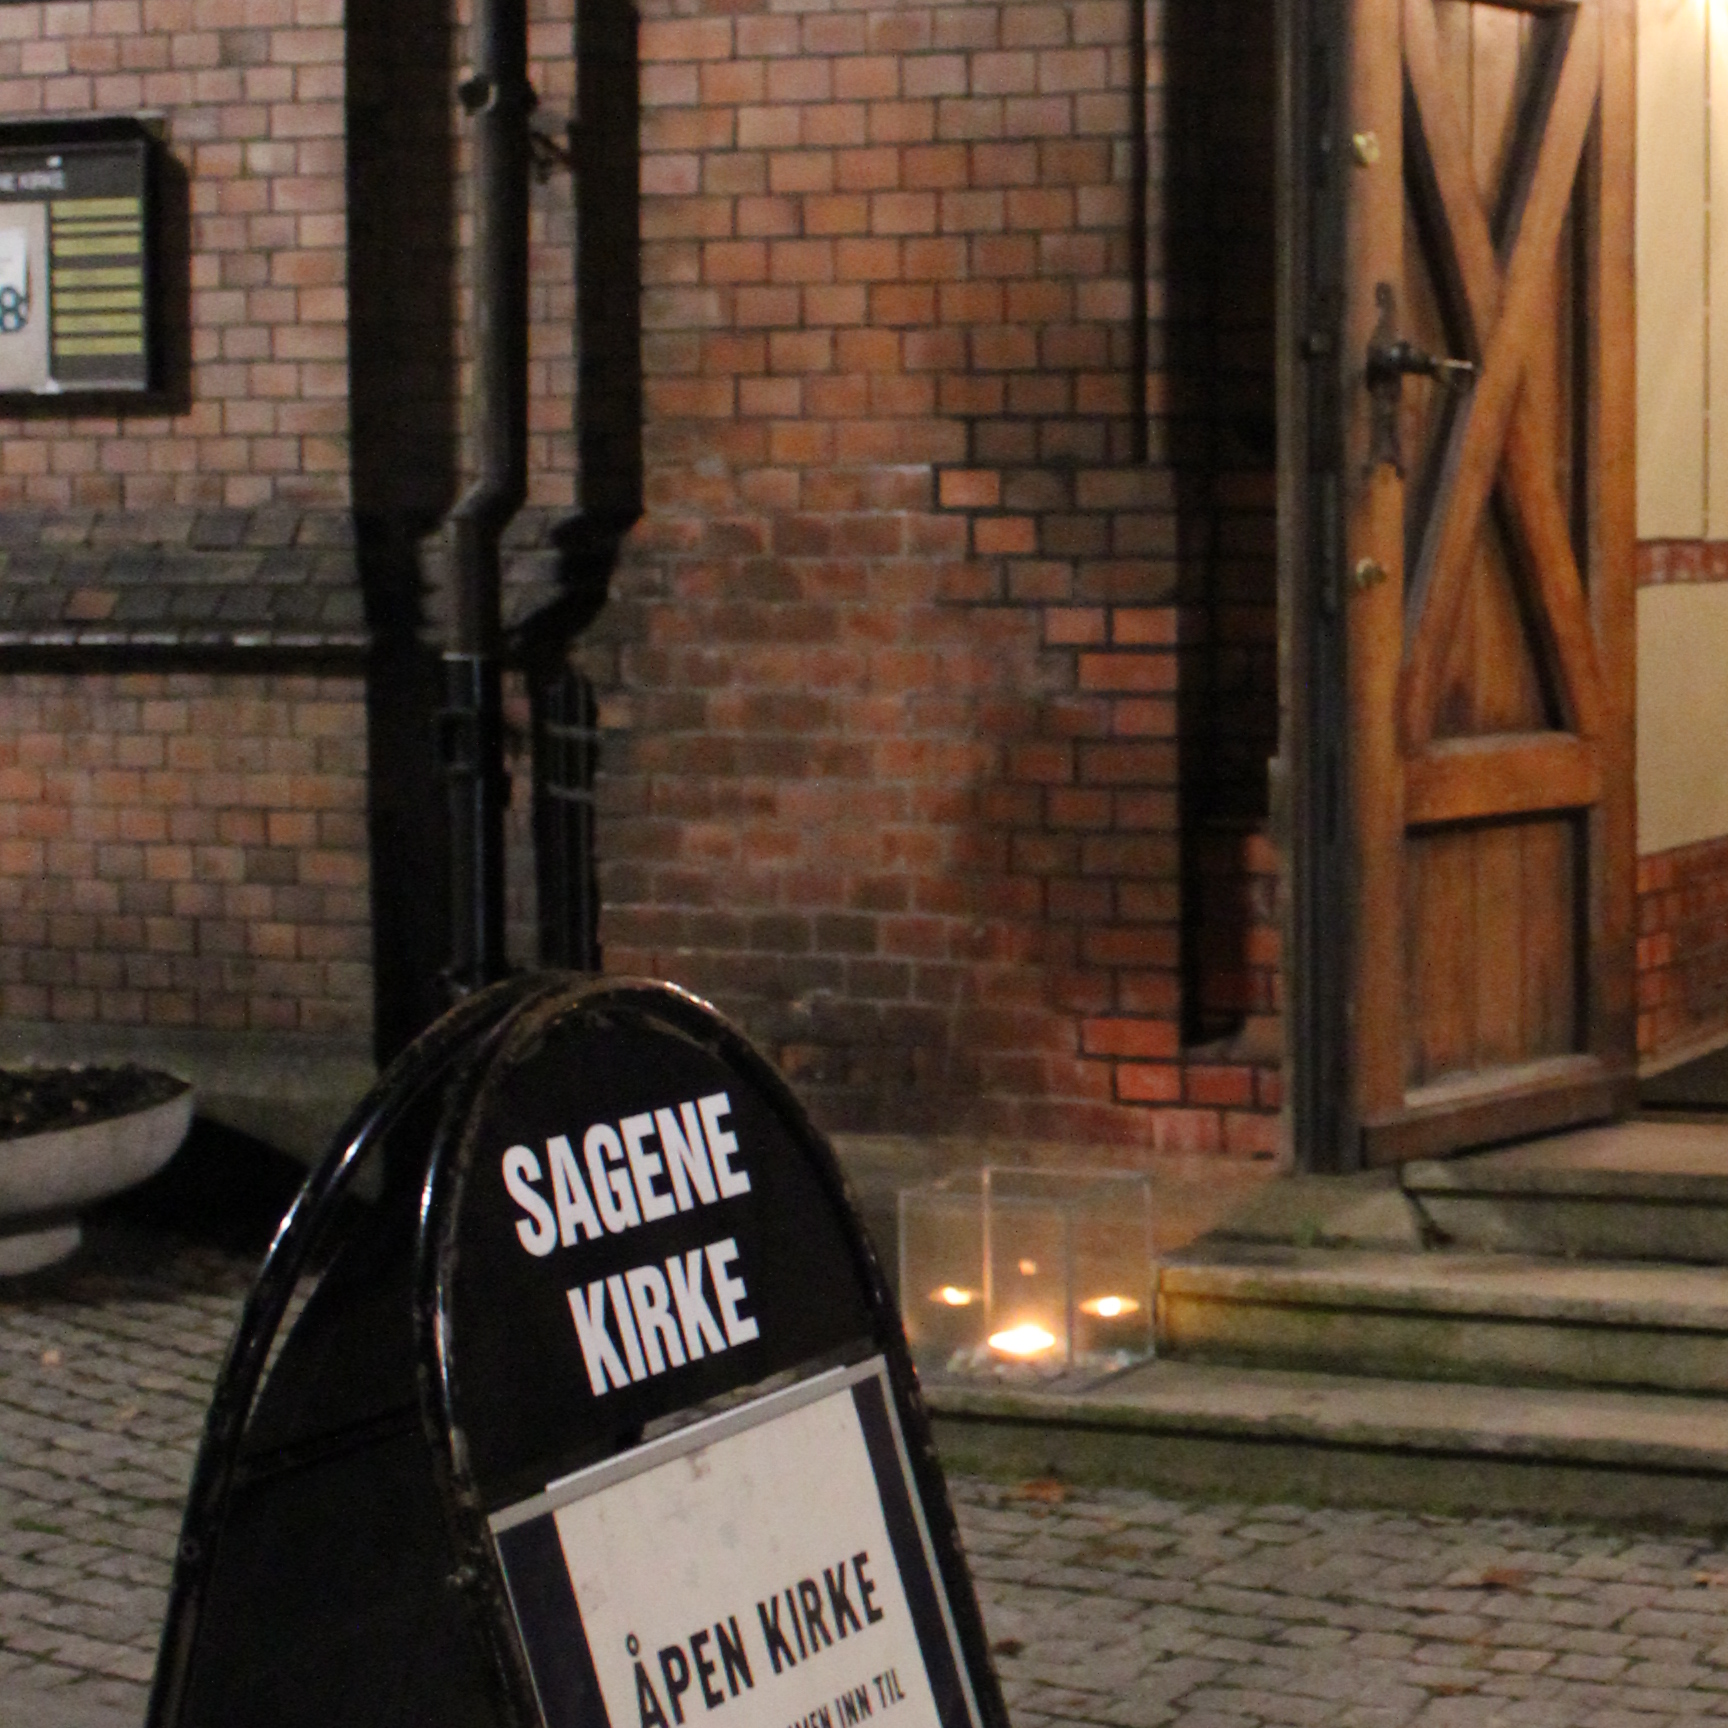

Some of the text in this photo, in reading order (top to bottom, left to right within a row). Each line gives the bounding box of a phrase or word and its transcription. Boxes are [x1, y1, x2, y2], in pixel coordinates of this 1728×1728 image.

[502, 1092, 751, 1257] SAGENE
[566, 1237, 760, 1397] KIRKE
[757, 1551, 883, 1674] KIRKE
[873, 1668, 905, 1709] TIL
